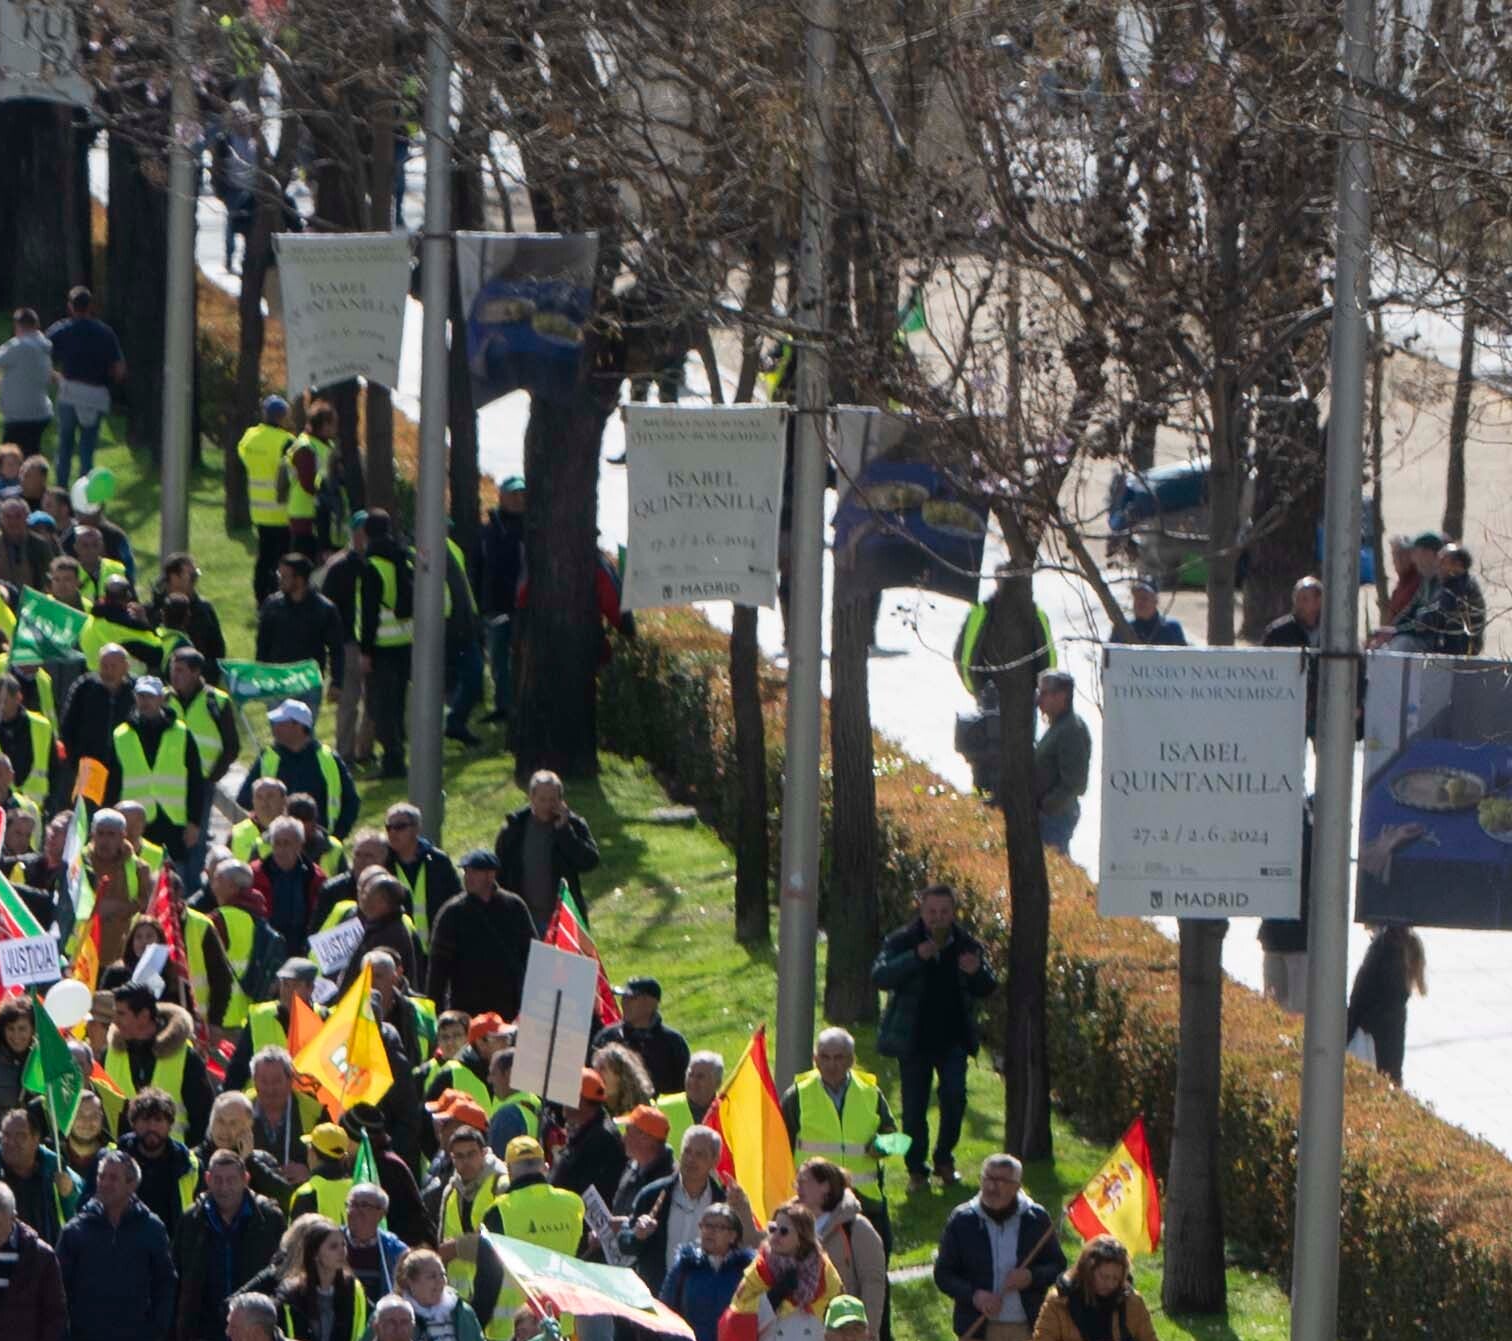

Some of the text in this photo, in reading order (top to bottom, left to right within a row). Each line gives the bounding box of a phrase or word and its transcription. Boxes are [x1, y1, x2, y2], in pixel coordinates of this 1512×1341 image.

[666, 471, 738, 488] ISABEL
[633, 491, 773, 519] QUINTANILLA
[680, 582, 740, 595] MADRID
[1128, 666, 1280, 682] MUSEO NACIONAL
[1112, 685, 1297, 703] THYSSEN-BORNEMISZA
[1158, 741, 1249, 765] ISABEL
[1109, 769, 1294, 798] QUINTANILLA
[1173, 892, 1249, 908] MADRID
